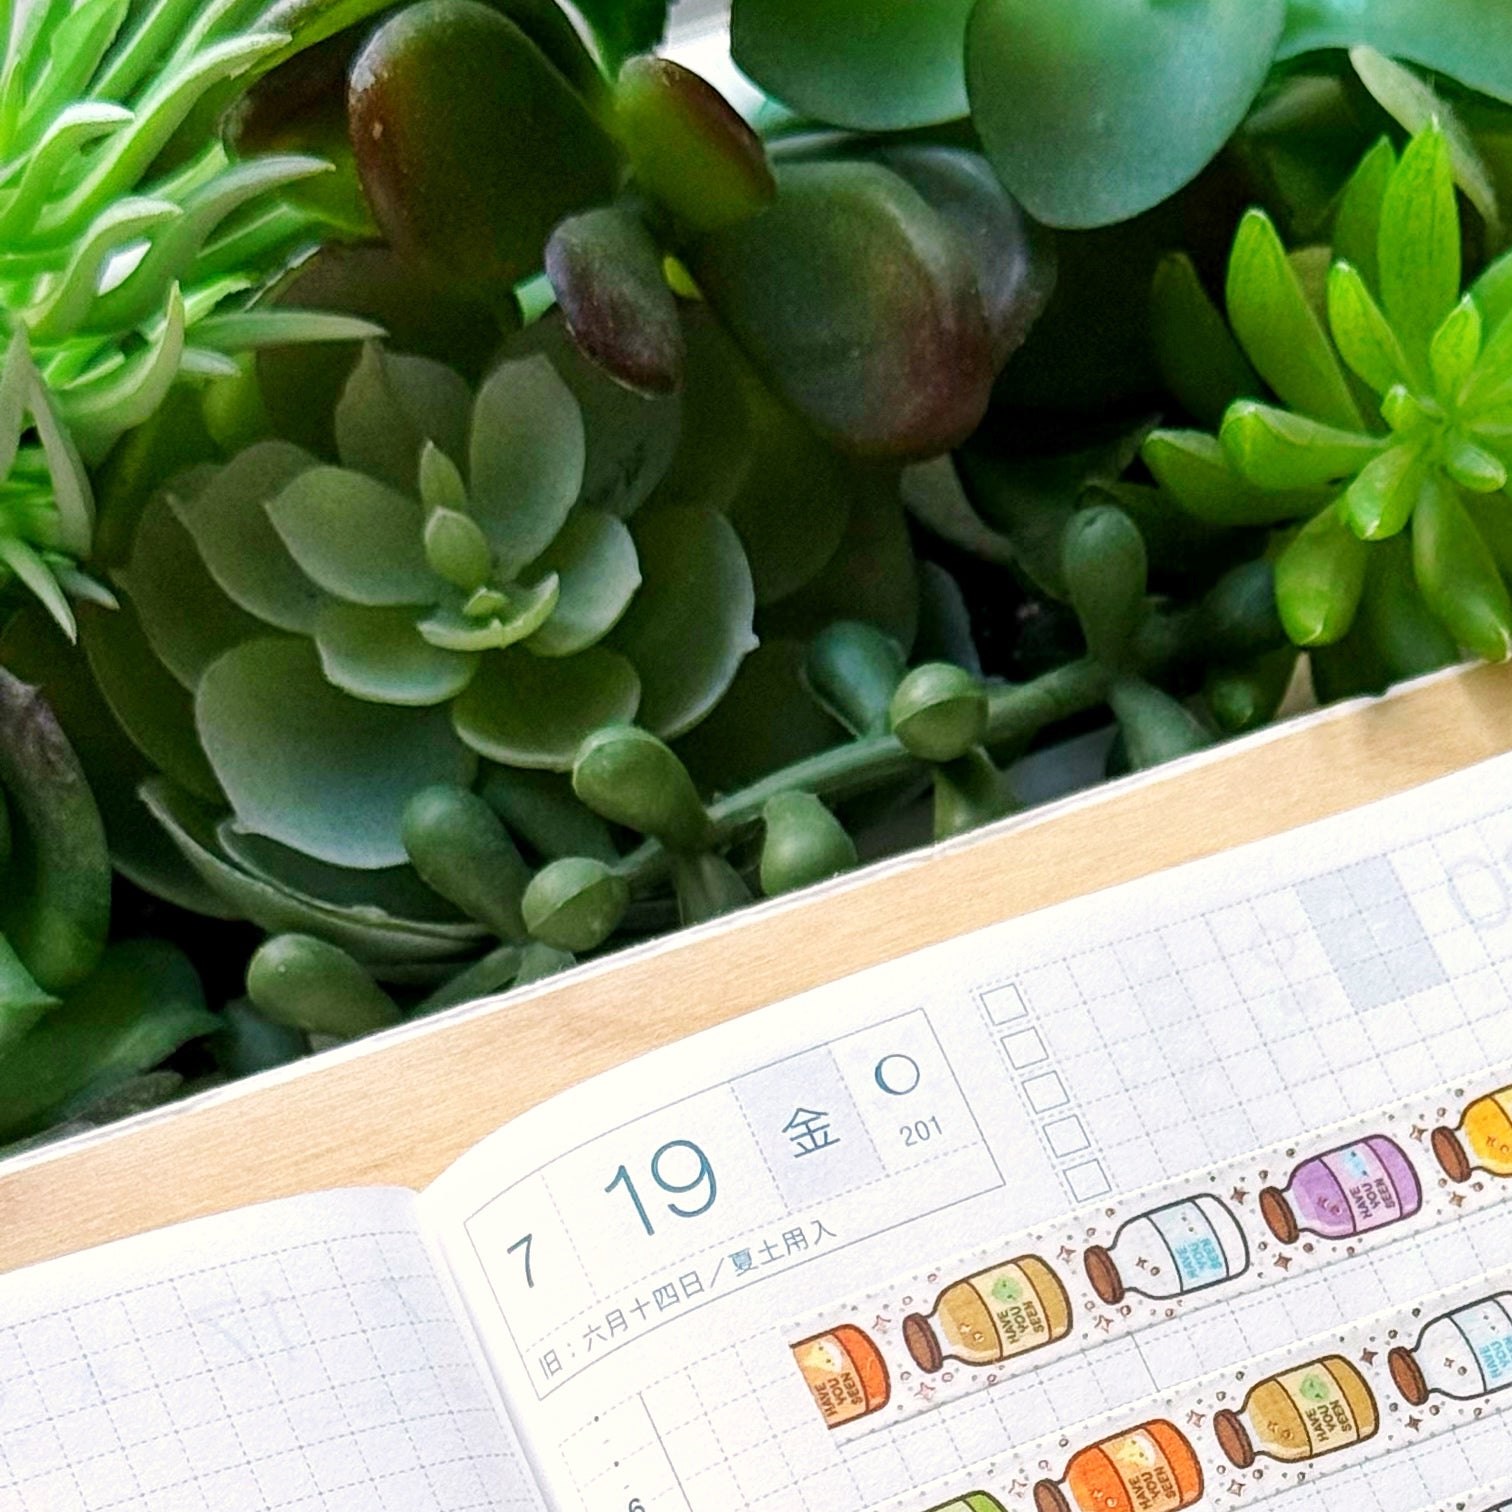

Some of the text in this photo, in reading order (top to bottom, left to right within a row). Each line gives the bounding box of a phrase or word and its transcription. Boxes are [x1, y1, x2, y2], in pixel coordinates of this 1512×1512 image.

[782, 1108, 840, 1158] 金
[900, 1115, 946, 1147] 201
[604, 1140, 716, 1235] 19
[507, 1234, 534, 1288] 7
[997, 1311, 1019, 1344] HAVE
[1010, 1306, 1029, 1334] YOU
[814, 1384, 837, 1417] HAVE
[827, 1378, 847, 1405] YOU
[1305, 1408, 1329, 1442] HAVE
[1318, 1405, 1337, 1432] YOU
[1128, 1477, 1153, 1510] HAVE
[1140, 1471, 1160, 1500] YOU
